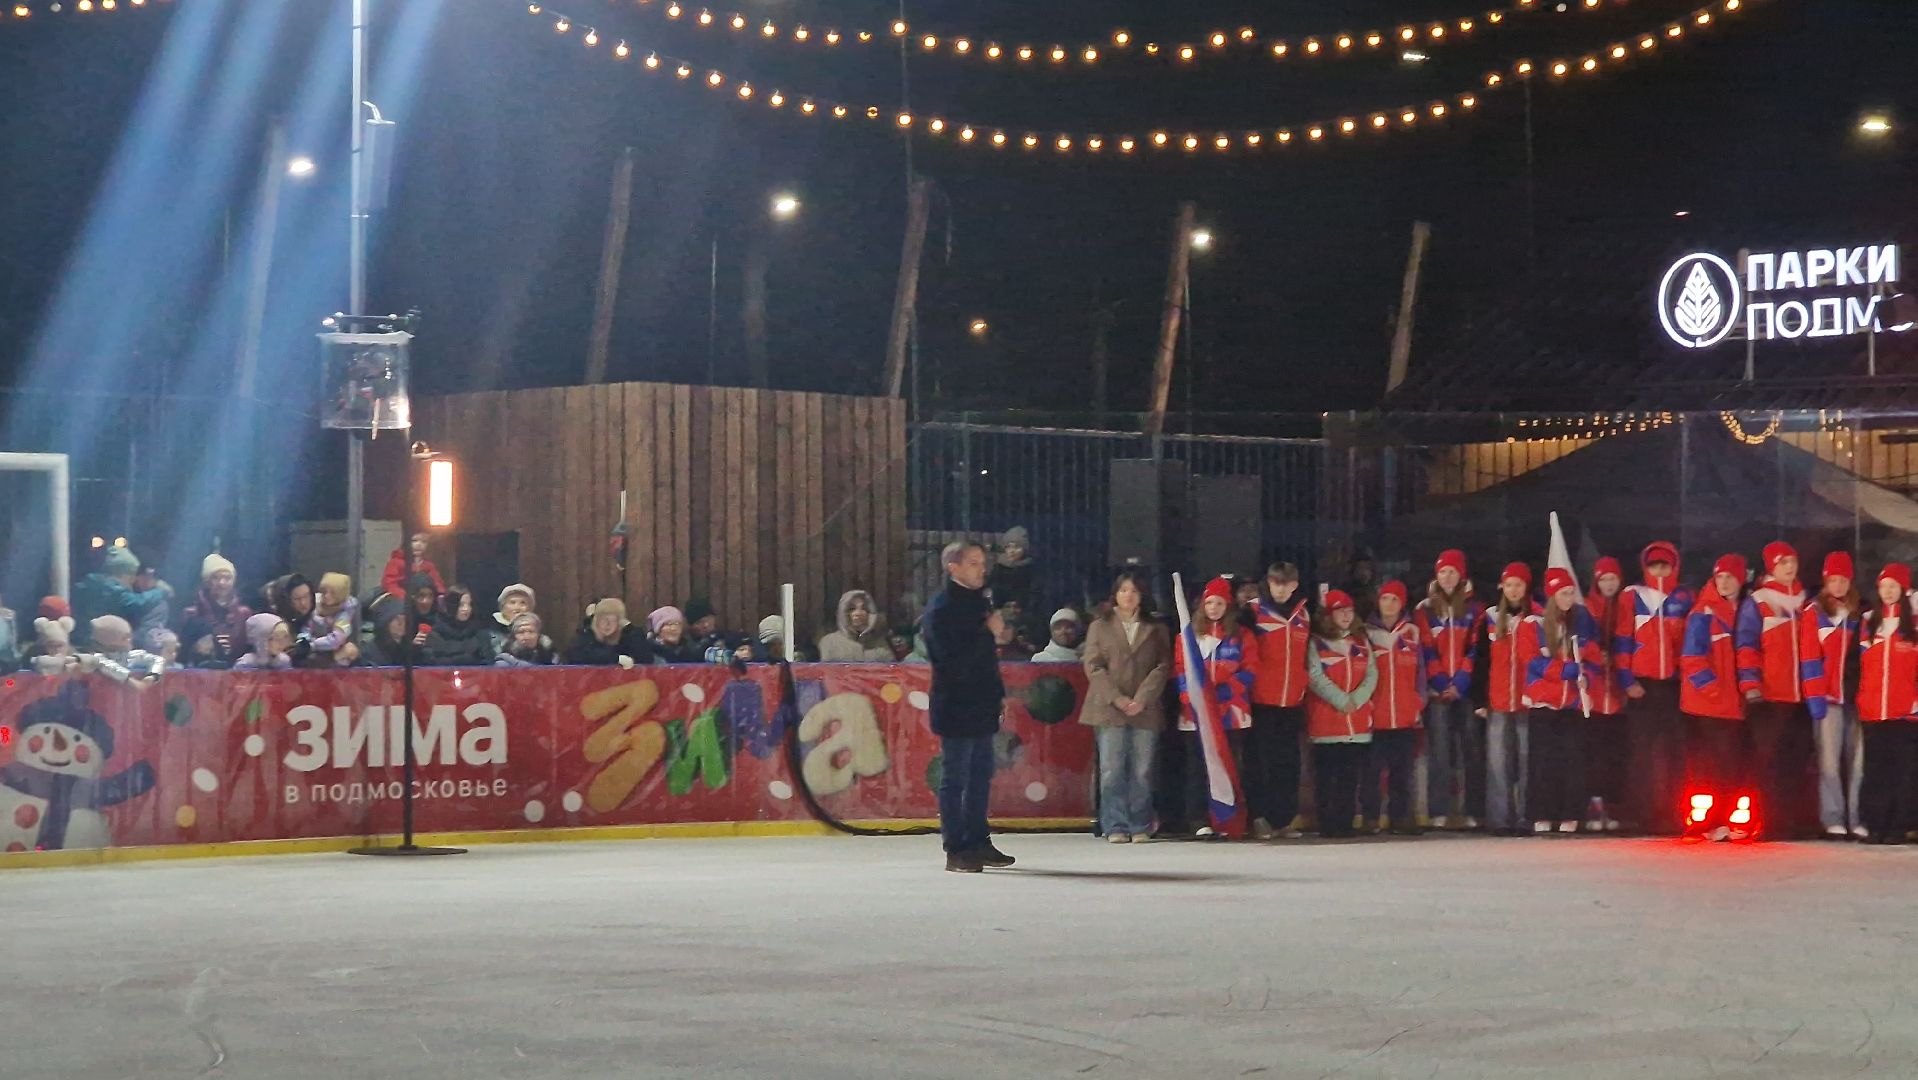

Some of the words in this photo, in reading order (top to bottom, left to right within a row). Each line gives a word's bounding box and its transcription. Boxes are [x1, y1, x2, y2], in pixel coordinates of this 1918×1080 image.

[1746, 244, 1897, 292] ПАРКИ
[1746, 293, 1914, 341] ПОДМ
[284, 785, 300, 804] в
[311, 778, 508, 804] подмосковье
